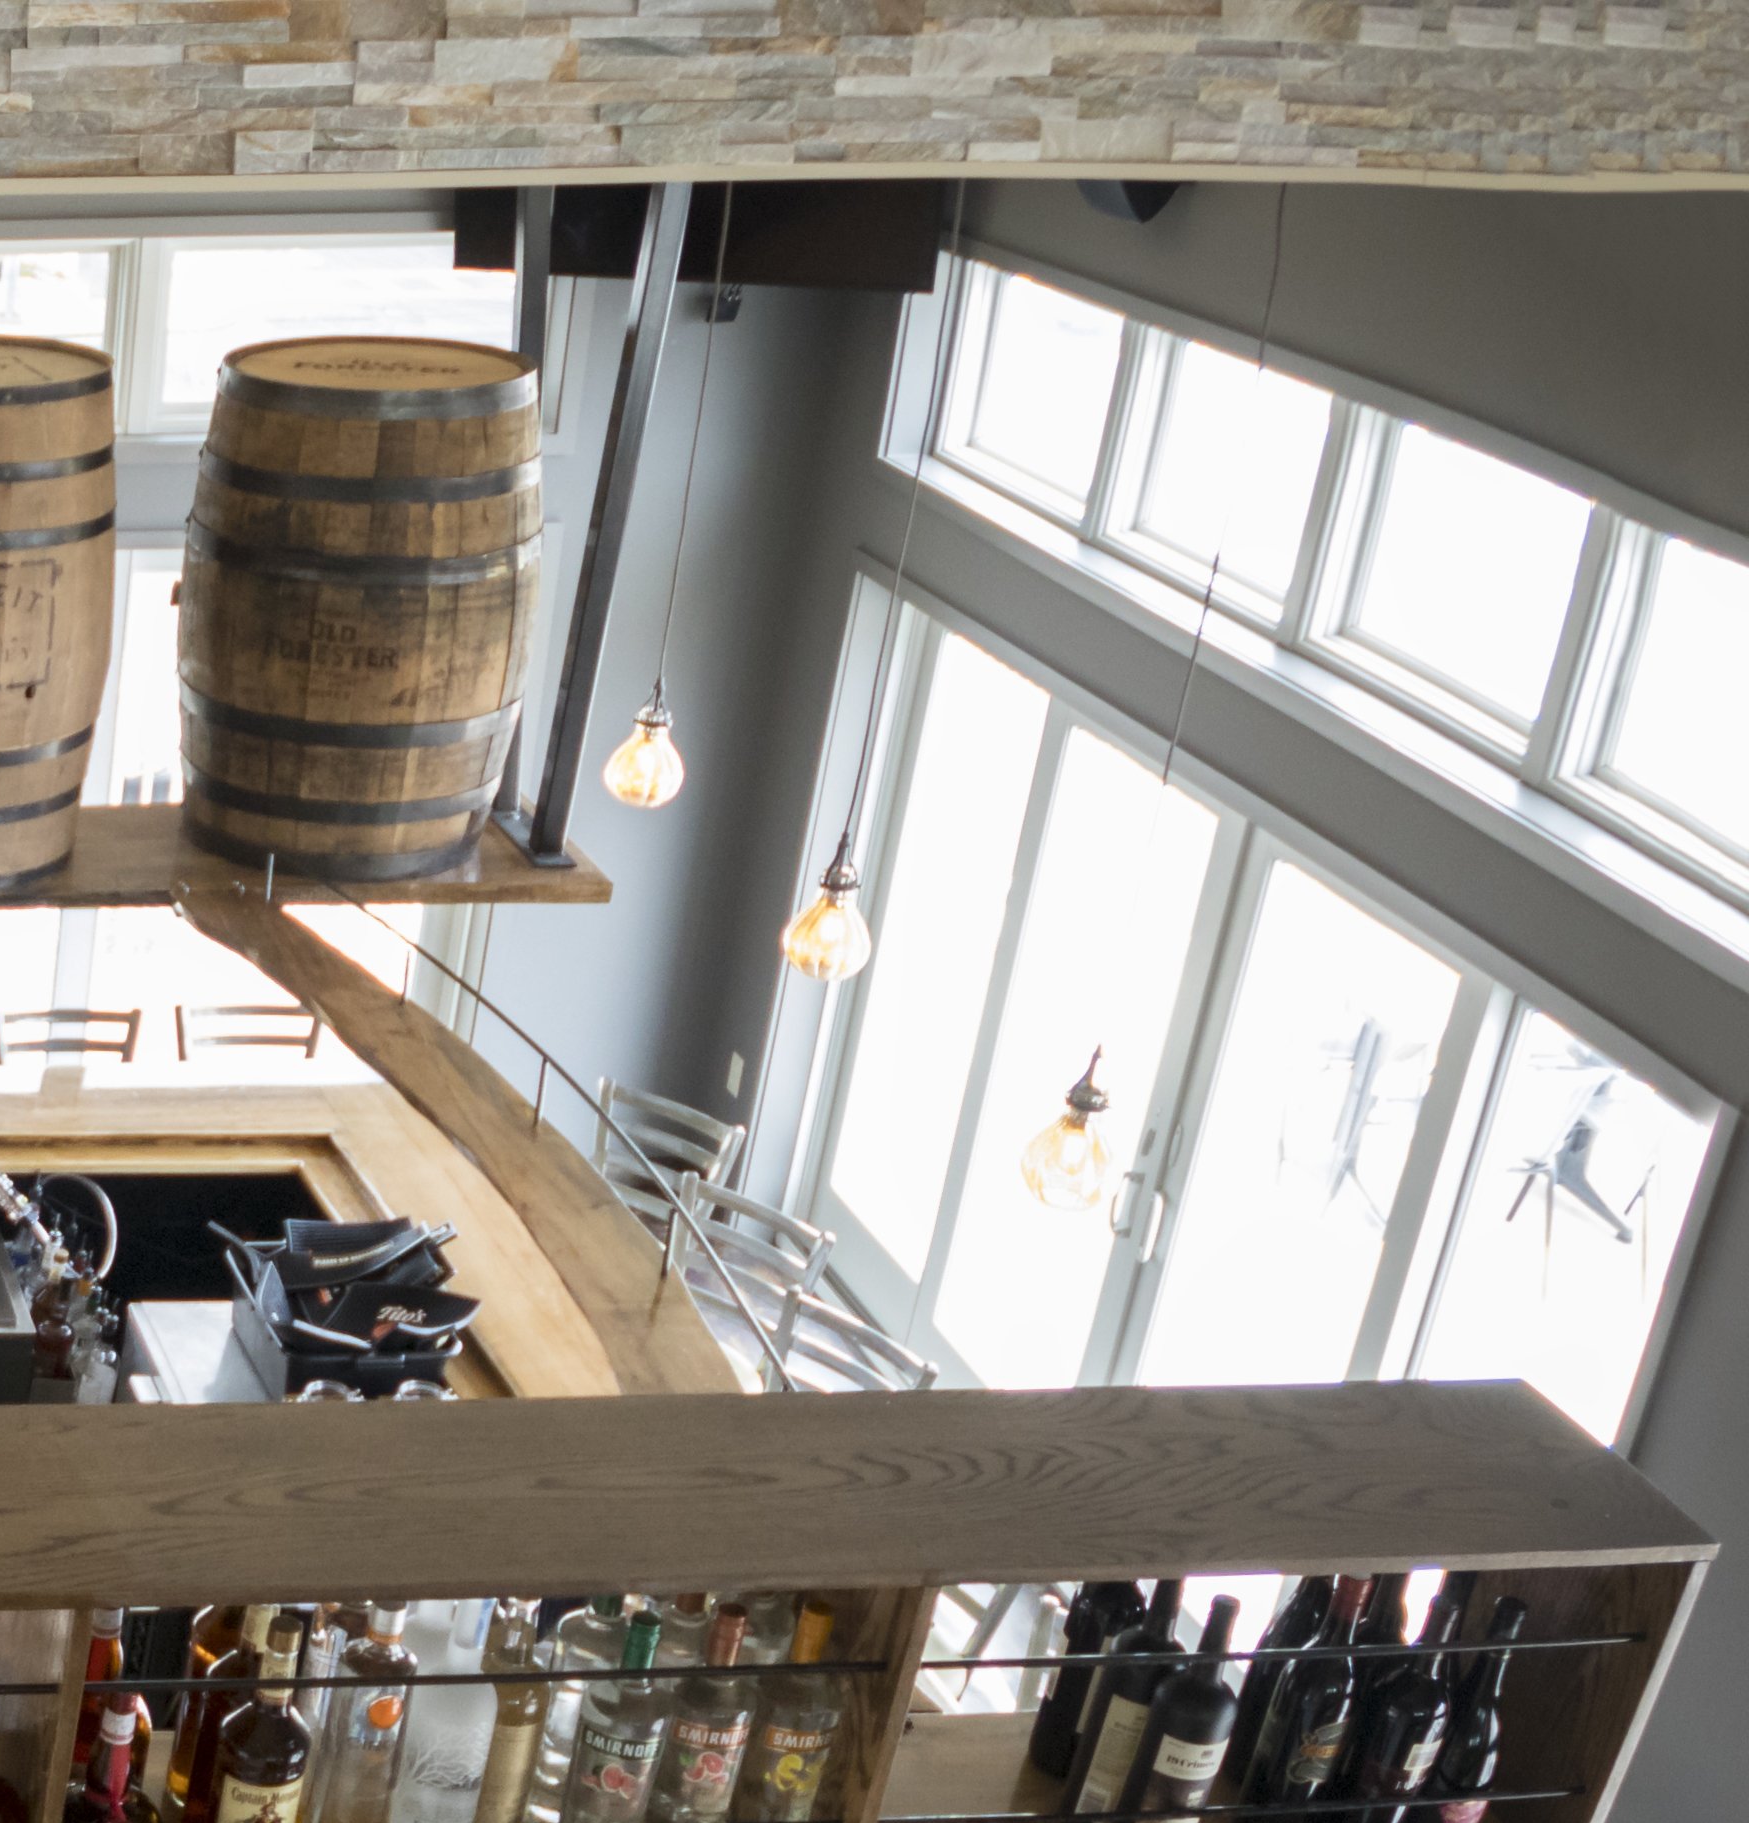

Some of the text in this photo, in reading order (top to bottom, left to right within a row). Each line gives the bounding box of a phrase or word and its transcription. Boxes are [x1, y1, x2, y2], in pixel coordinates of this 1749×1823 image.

[310, 618, 358, 642] OLD
[263, 634, 400, 671] FORESTER
[376, 1304, 428, 1324] Tito's
[584, 1730, 660, 1759] SMIRNOFF
